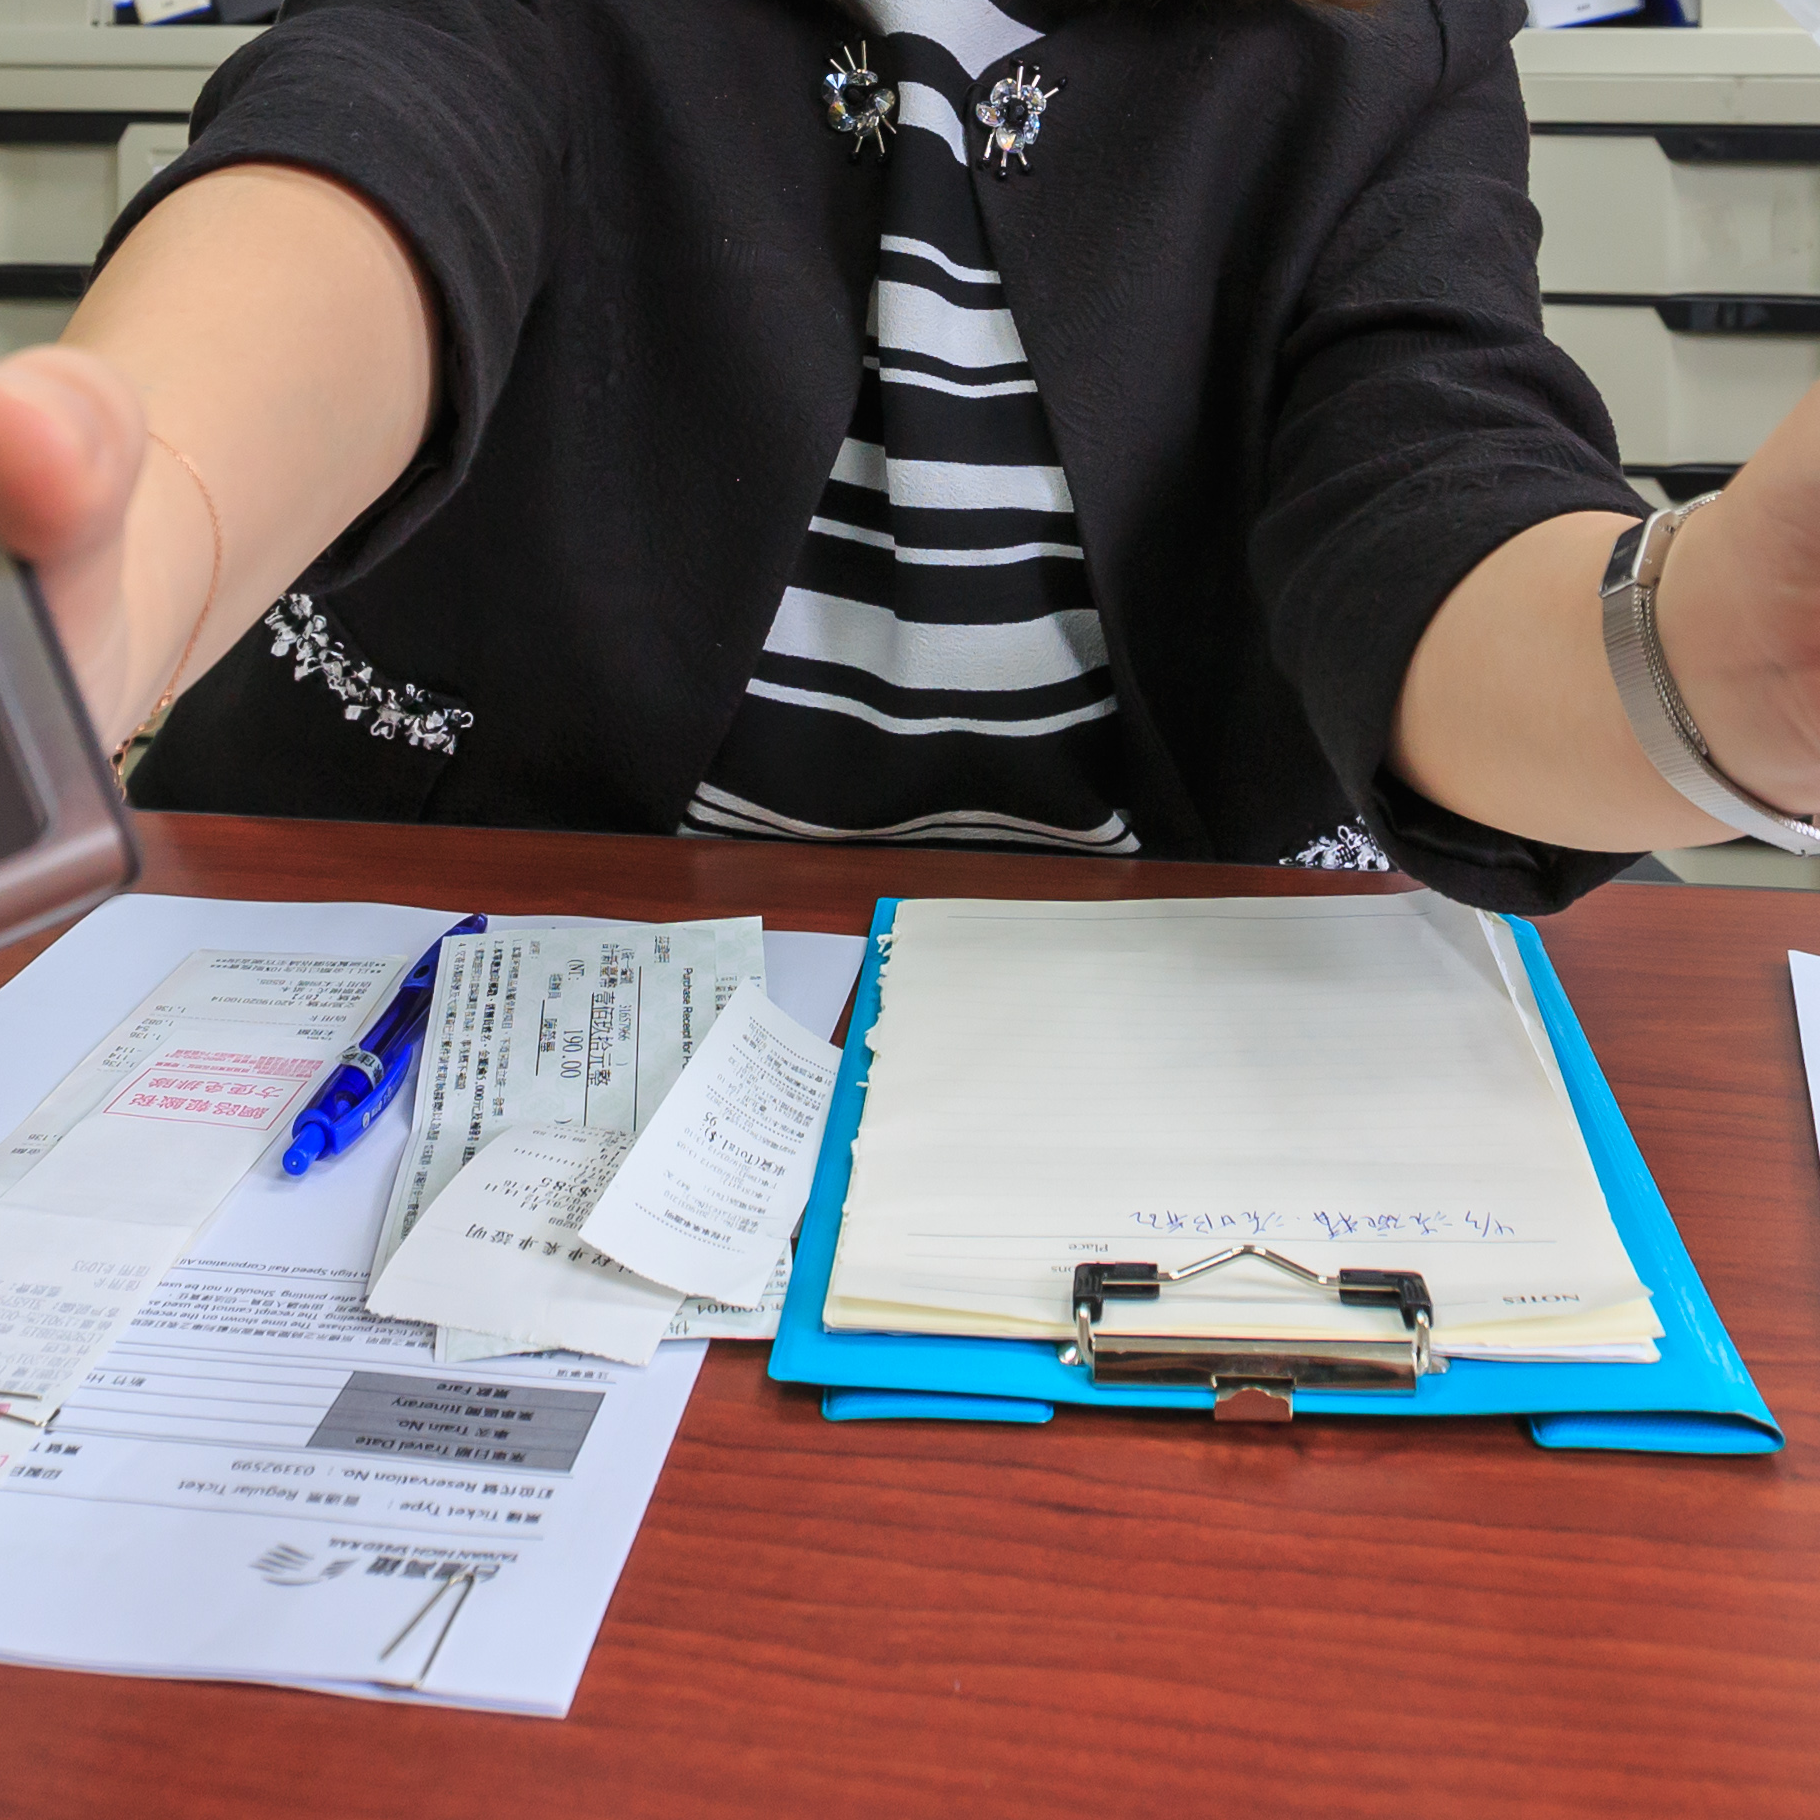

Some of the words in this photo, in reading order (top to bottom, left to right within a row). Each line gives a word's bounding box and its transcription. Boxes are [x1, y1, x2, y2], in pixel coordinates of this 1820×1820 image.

[682, 966, 694, 1005] Purchase
[682, 1006, 694, 1040] Receipt
[588, 990, 616, 1088] 壹佰玖拾元整
[560, 1029, 584, 1079] 190.00
[147, 1077, 284, 1099] 方便免排隊
[128, 1093, 270, 1120] 網路報繳稅
[1068, 1241, 1110, 1254] Place
[1502, 1293, 1580, 1306] NOTES
[435, 1382, 472, 1397] Fare
[389, 1396, 463, 1416] Itinerary
[426, 1420, 469, 1438] Train
[353, 1435, 398, 1451] Date
[398, 1439, 452, 1462] Travel
[176, 1479, 228, 1497] Ticket
[373, 1471, 479, 1495] Reservation
[231, 1484, 300, 1502] Regular
[398, 1500, 441, 1517] Type
[446, 1505, 500, 1523] Ticket
